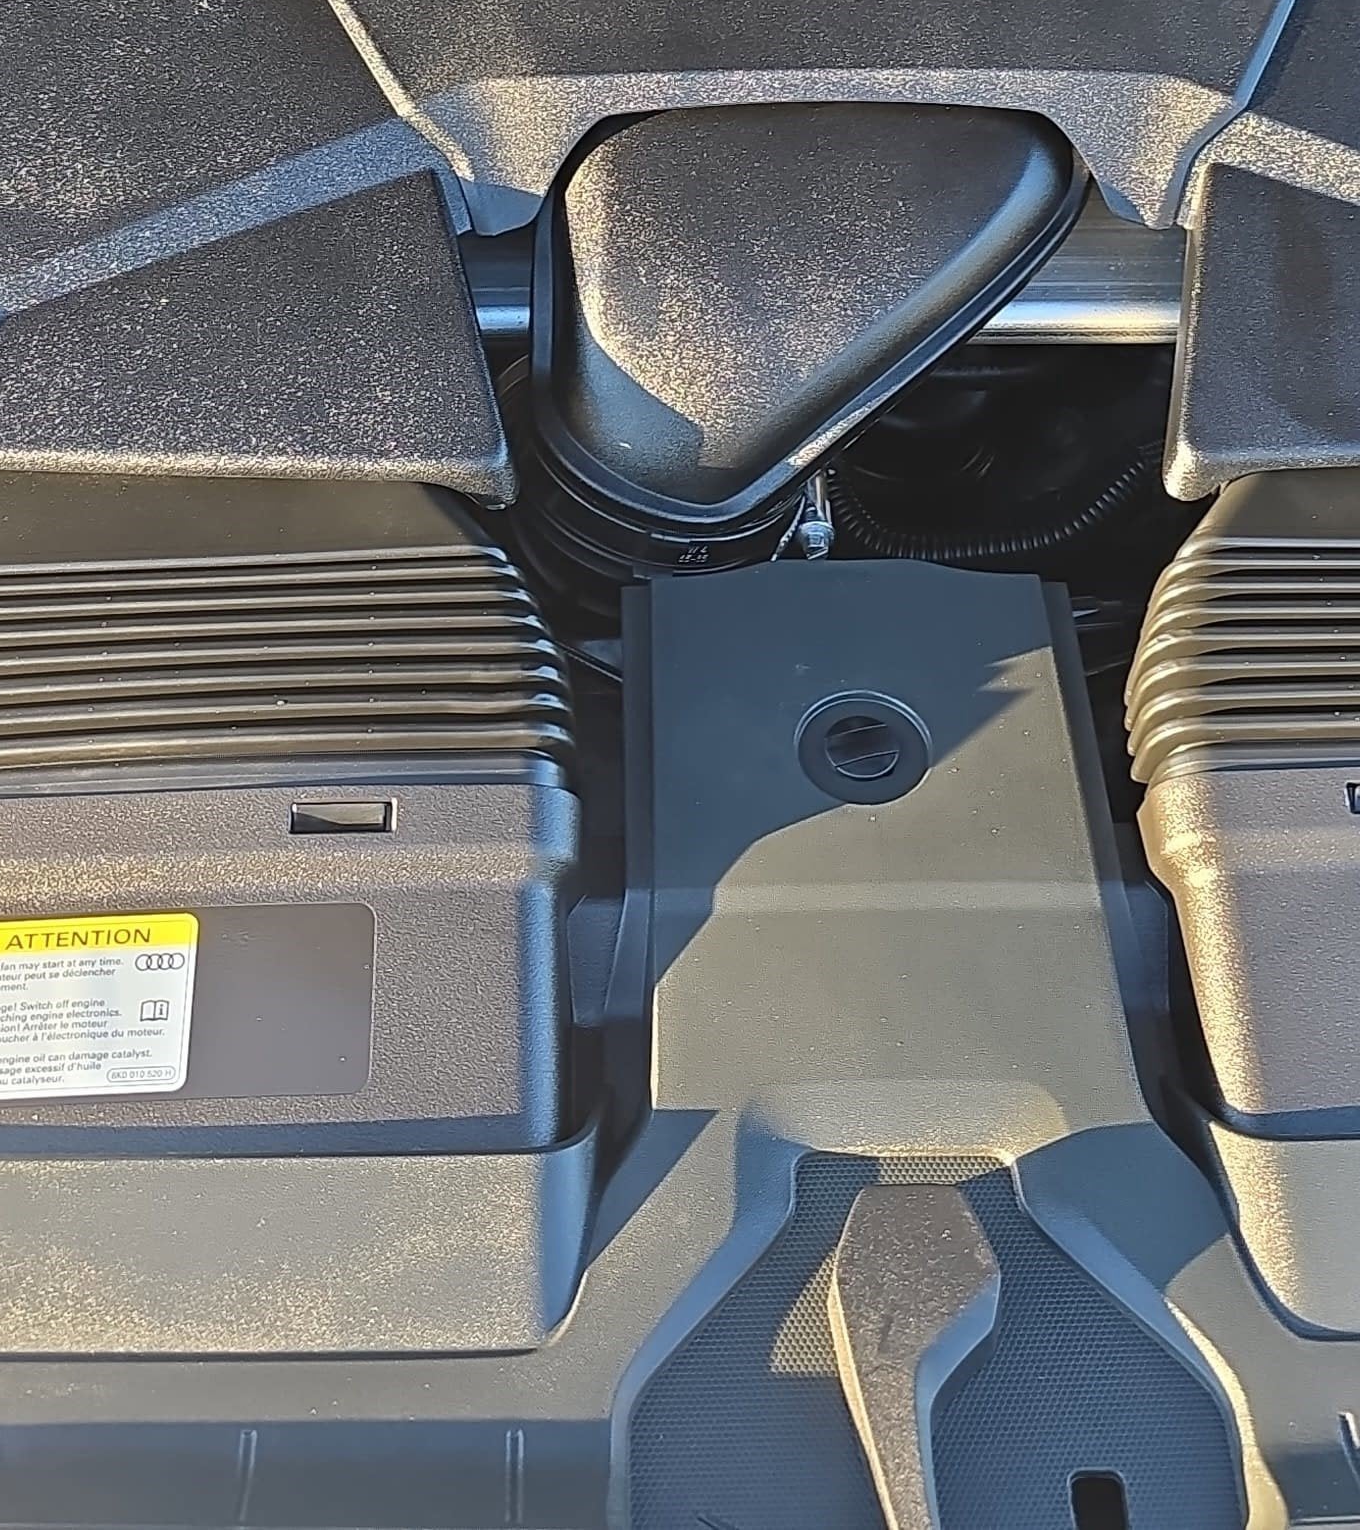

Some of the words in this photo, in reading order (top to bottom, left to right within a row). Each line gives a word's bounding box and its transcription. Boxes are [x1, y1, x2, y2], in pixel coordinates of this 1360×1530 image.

[5, 926, 152, 950] ATTENTION
[0, 962, 16, 971] fan
[18, 962, 38, 972] may
[42, 960, 64, 968] start
[66, 959, 77, 967] at
[78, 959, 96, 969] any
[99, 956, 124, 966] time.
[23, 971, 46, 981] peut
[62, 966, 115, 978] déclencher
[19, 1000, 53, 1010] Switch
[55, 999, 69, 1008] off
[71, 998, 105, 1009] engine
[29, 1011, 63, 1022] engine
[66, 1007, 122, 1018] electronics.
[22, 1021, 57, 1031] Arrêter
[60, 1020, 69, 1029] le
[71, 1019, 107, 1028] moteur
[31, 1032, 38, 1041] à
[111, 1028, 123, 1037] du
[127, 1027, 164, 1037] moteur.
[32, 1053, 45, 1062] oil
[47, 1054, 66, 1062] can
[68, 1050, 108, 1062] damage
[110, 1048, 152, 1060] catalyst.
[24, 1063, 65, 1073] excessif
[11, 1074, 64, 1085] catalyseur.
